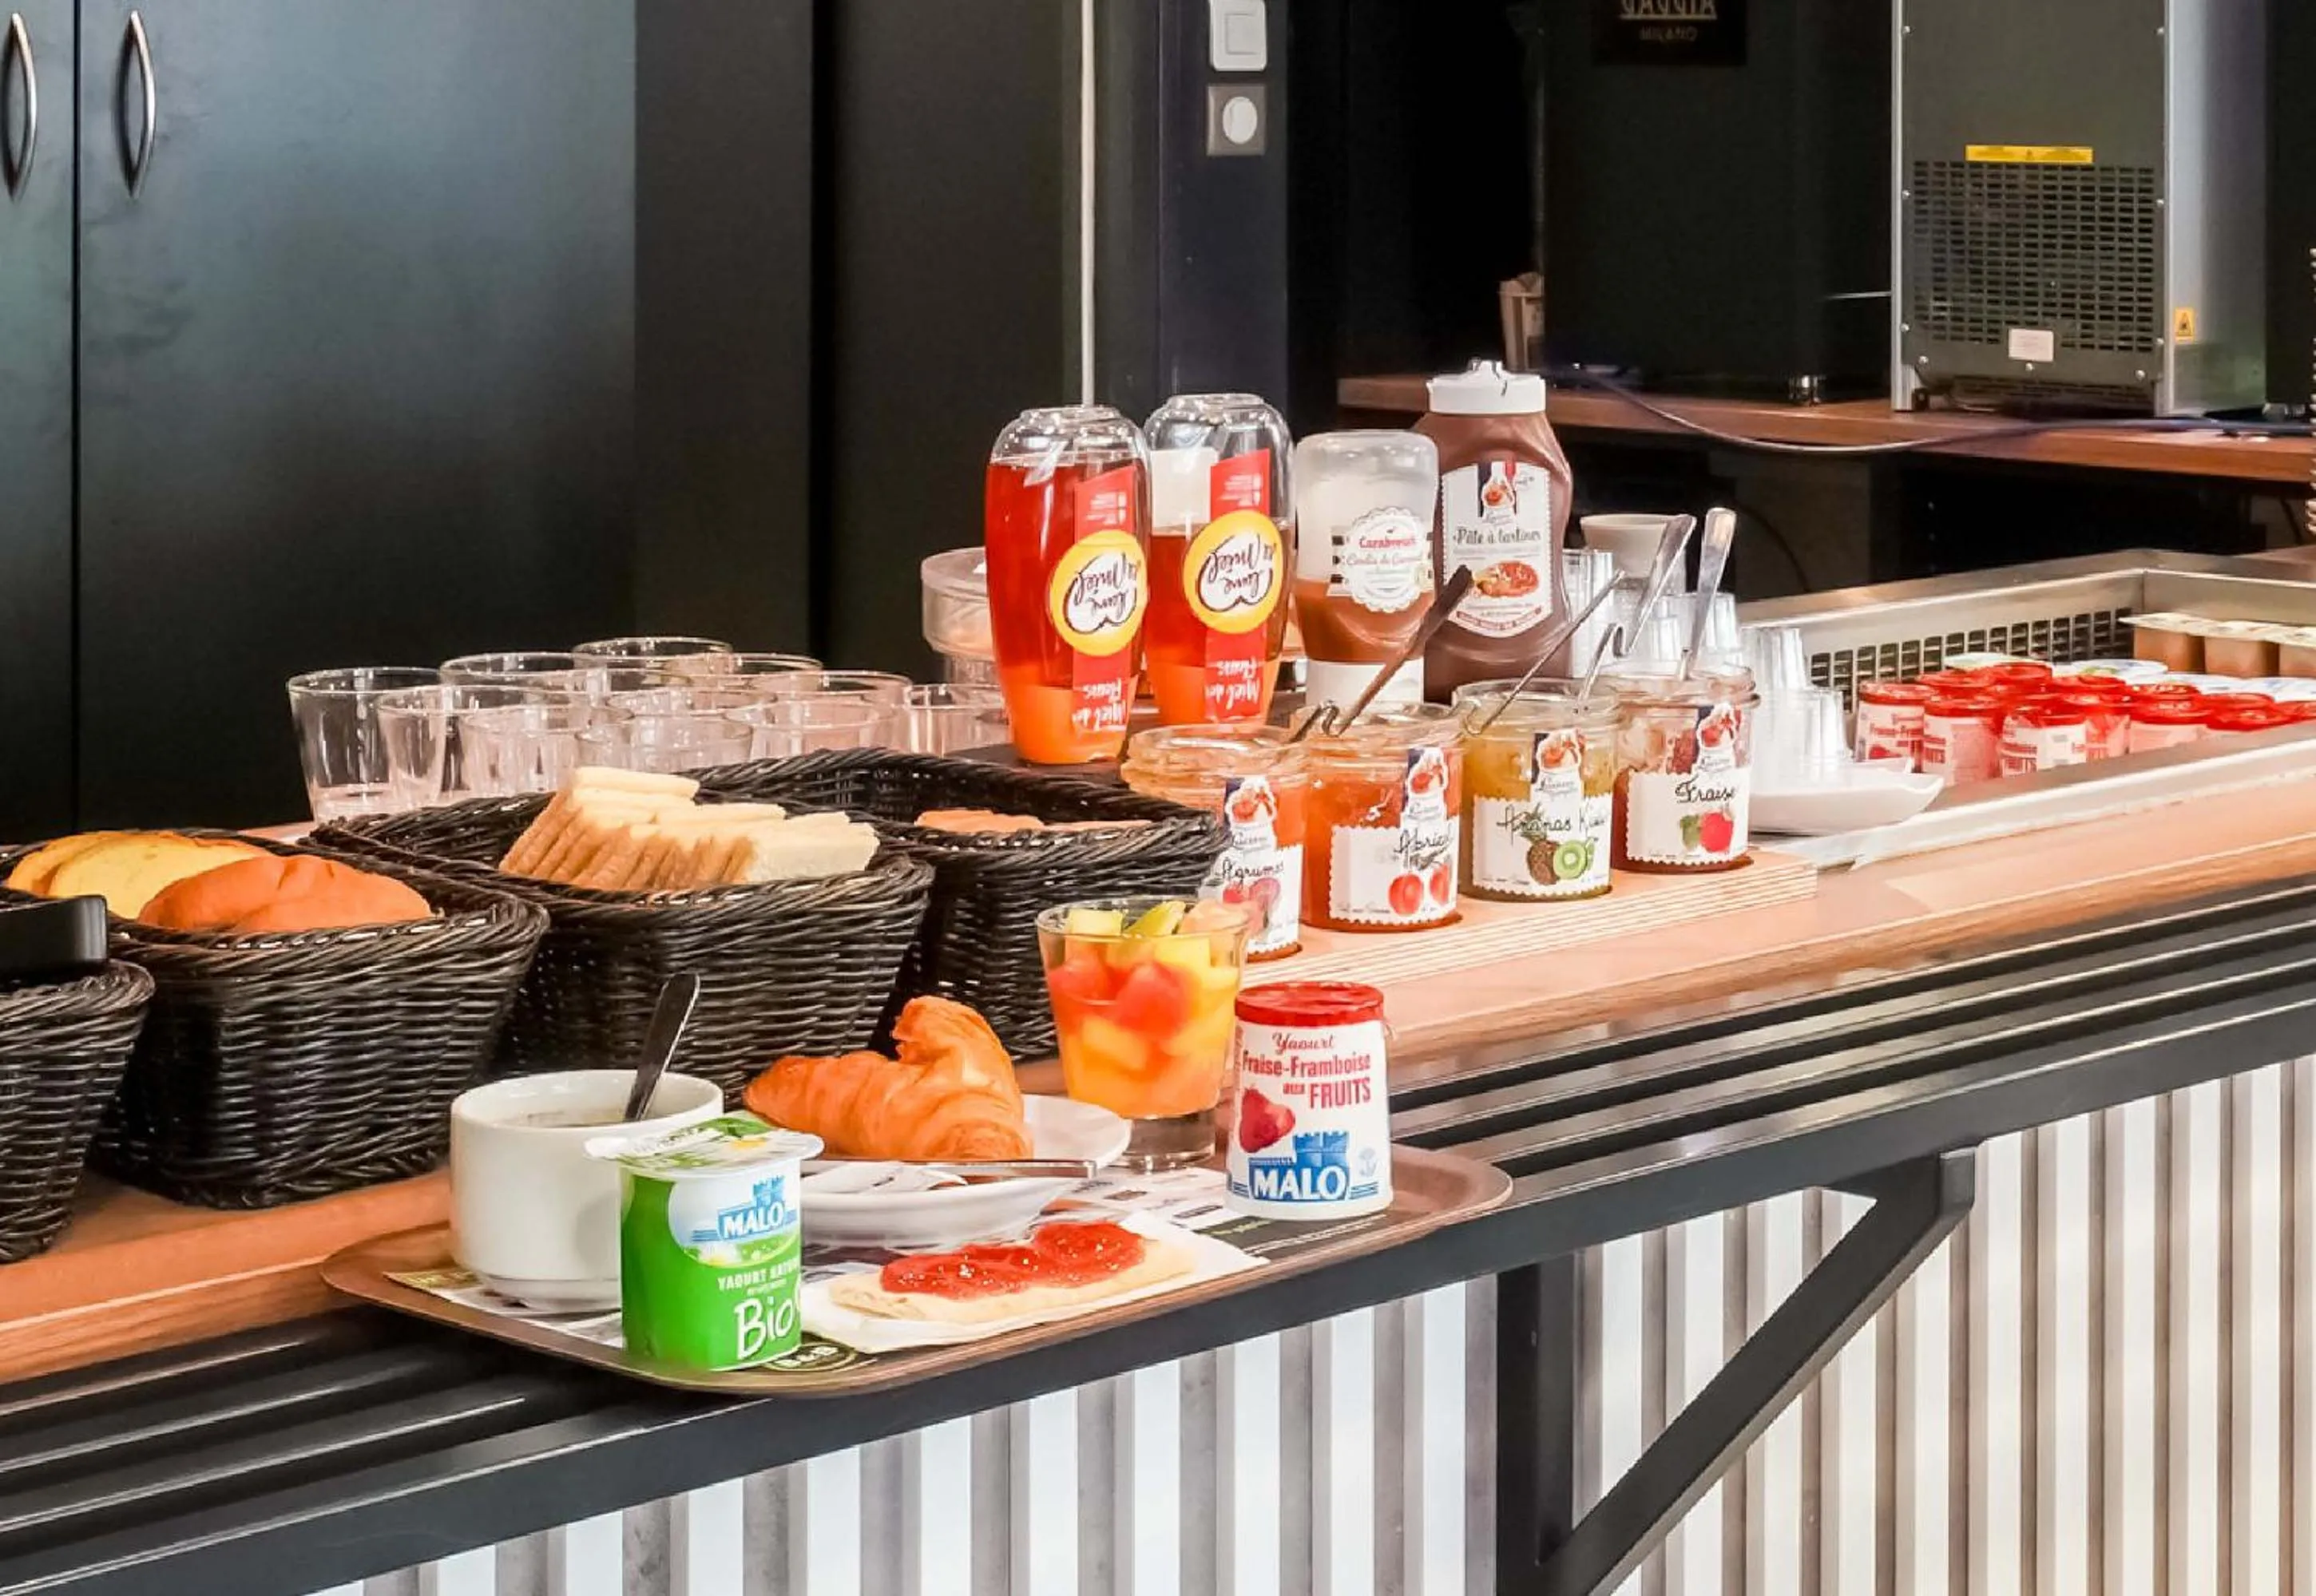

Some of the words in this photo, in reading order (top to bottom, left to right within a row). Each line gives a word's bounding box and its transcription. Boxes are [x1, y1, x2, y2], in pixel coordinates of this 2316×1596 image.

[1271, 1031, 1336, 1055] Yaourt
[1310, 1076, 1371, 1109] FRUITS
[1254, 1165, 1347, 1200] MALO
[724, 1201, 785, 1239] MALO
[718, 1268, 767, 1291] YAOURT
[733, 1295, 794, 1360] Bio
